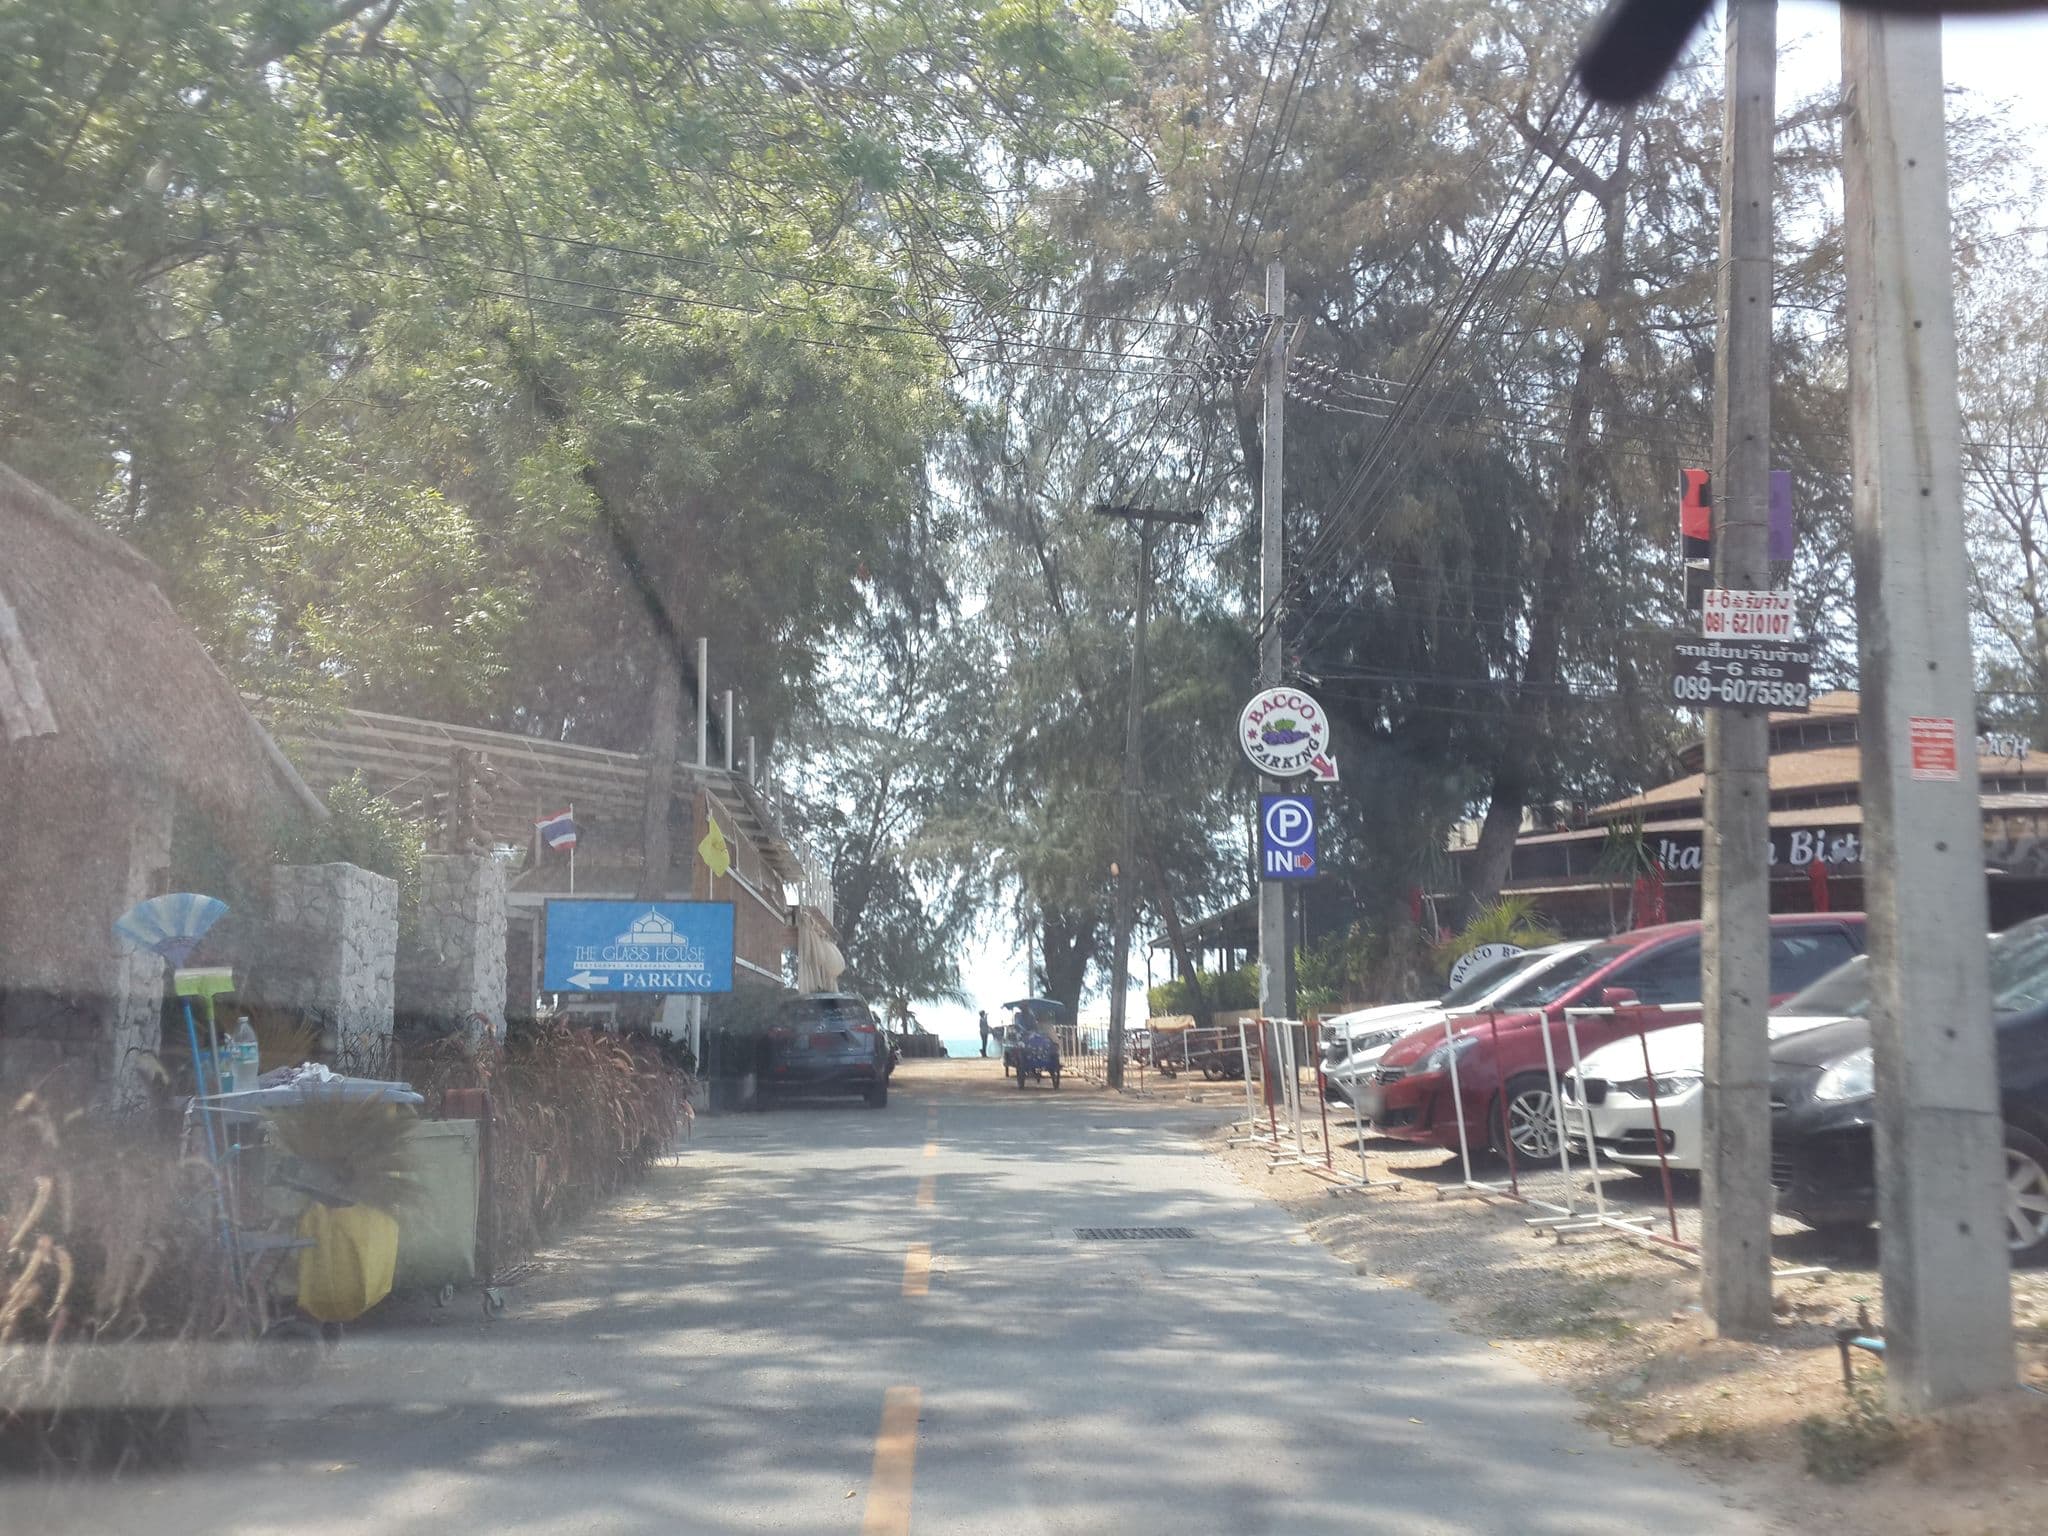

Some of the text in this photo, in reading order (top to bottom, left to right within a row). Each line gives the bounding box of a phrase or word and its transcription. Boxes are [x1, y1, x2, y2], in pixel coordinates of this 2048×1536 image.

[1695, 660, 1744, 676] 4-6
[1674, 675, 1807, 707] 089-6075582
[1249, 694, 1315, 725] BACCO
[1251, 738, 1320, 769] PARKING
[1279, 808, 1302, 838] P
[1267, 850, 1294, 872] IN
[1790, 829, 1864, 865] Bist
[576, 945, 704, 961] THE GLASS HOUSE
[1453, 948, 1491, 984] BACCO
[623, 972, 711, 988] PARKING
